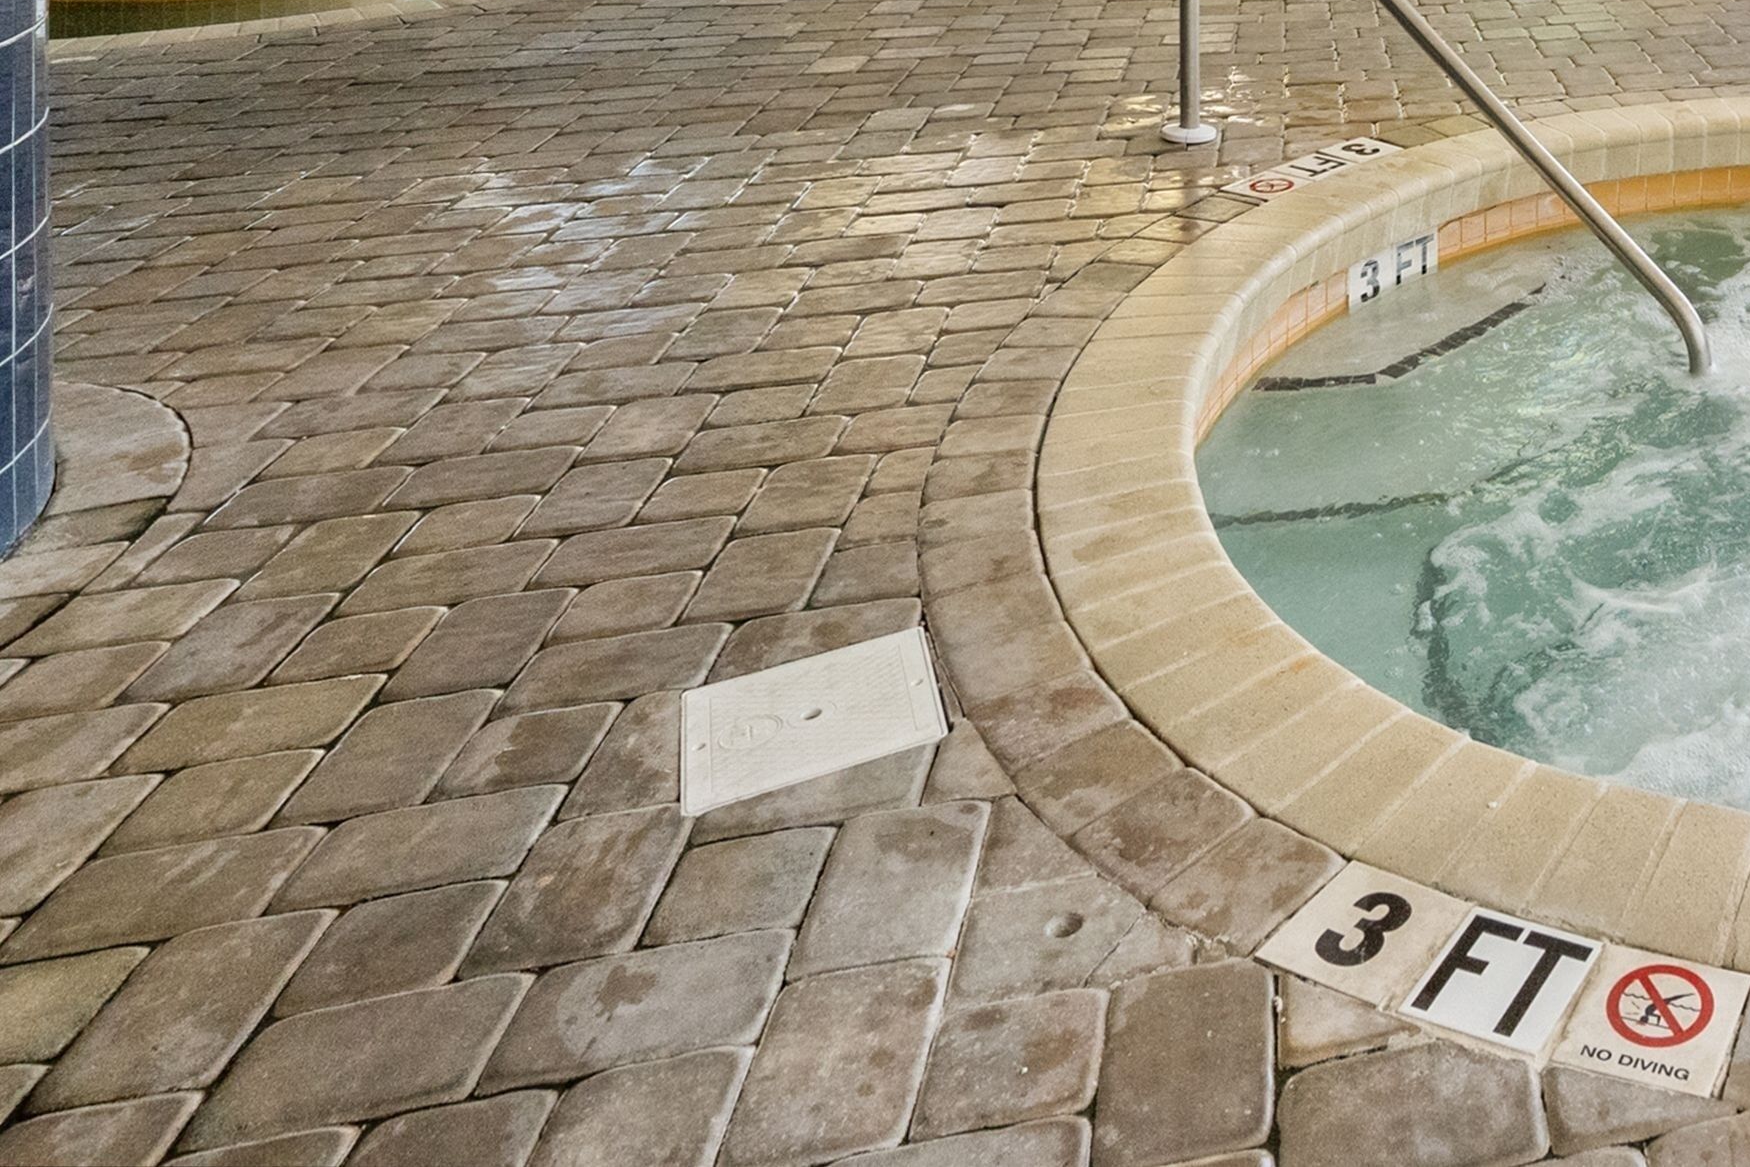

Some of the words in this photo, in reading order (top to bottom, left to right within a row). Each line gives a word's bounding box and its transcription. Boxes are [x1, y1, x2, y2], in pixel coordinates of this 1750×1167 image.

[1288, 155, 1347, 177] FT
[1341, 143, 1381, 156] 3
[1360, 259, 1380, 303] 3
[1396, 233, 1435, 285] FT
[1314, 891, 1413, 967] 3
[1411, 914, 1594, 1039] FT
[1579, 1044, 1614, 1063] NO
[1618, 1053, 1691, 1082] DIVING
